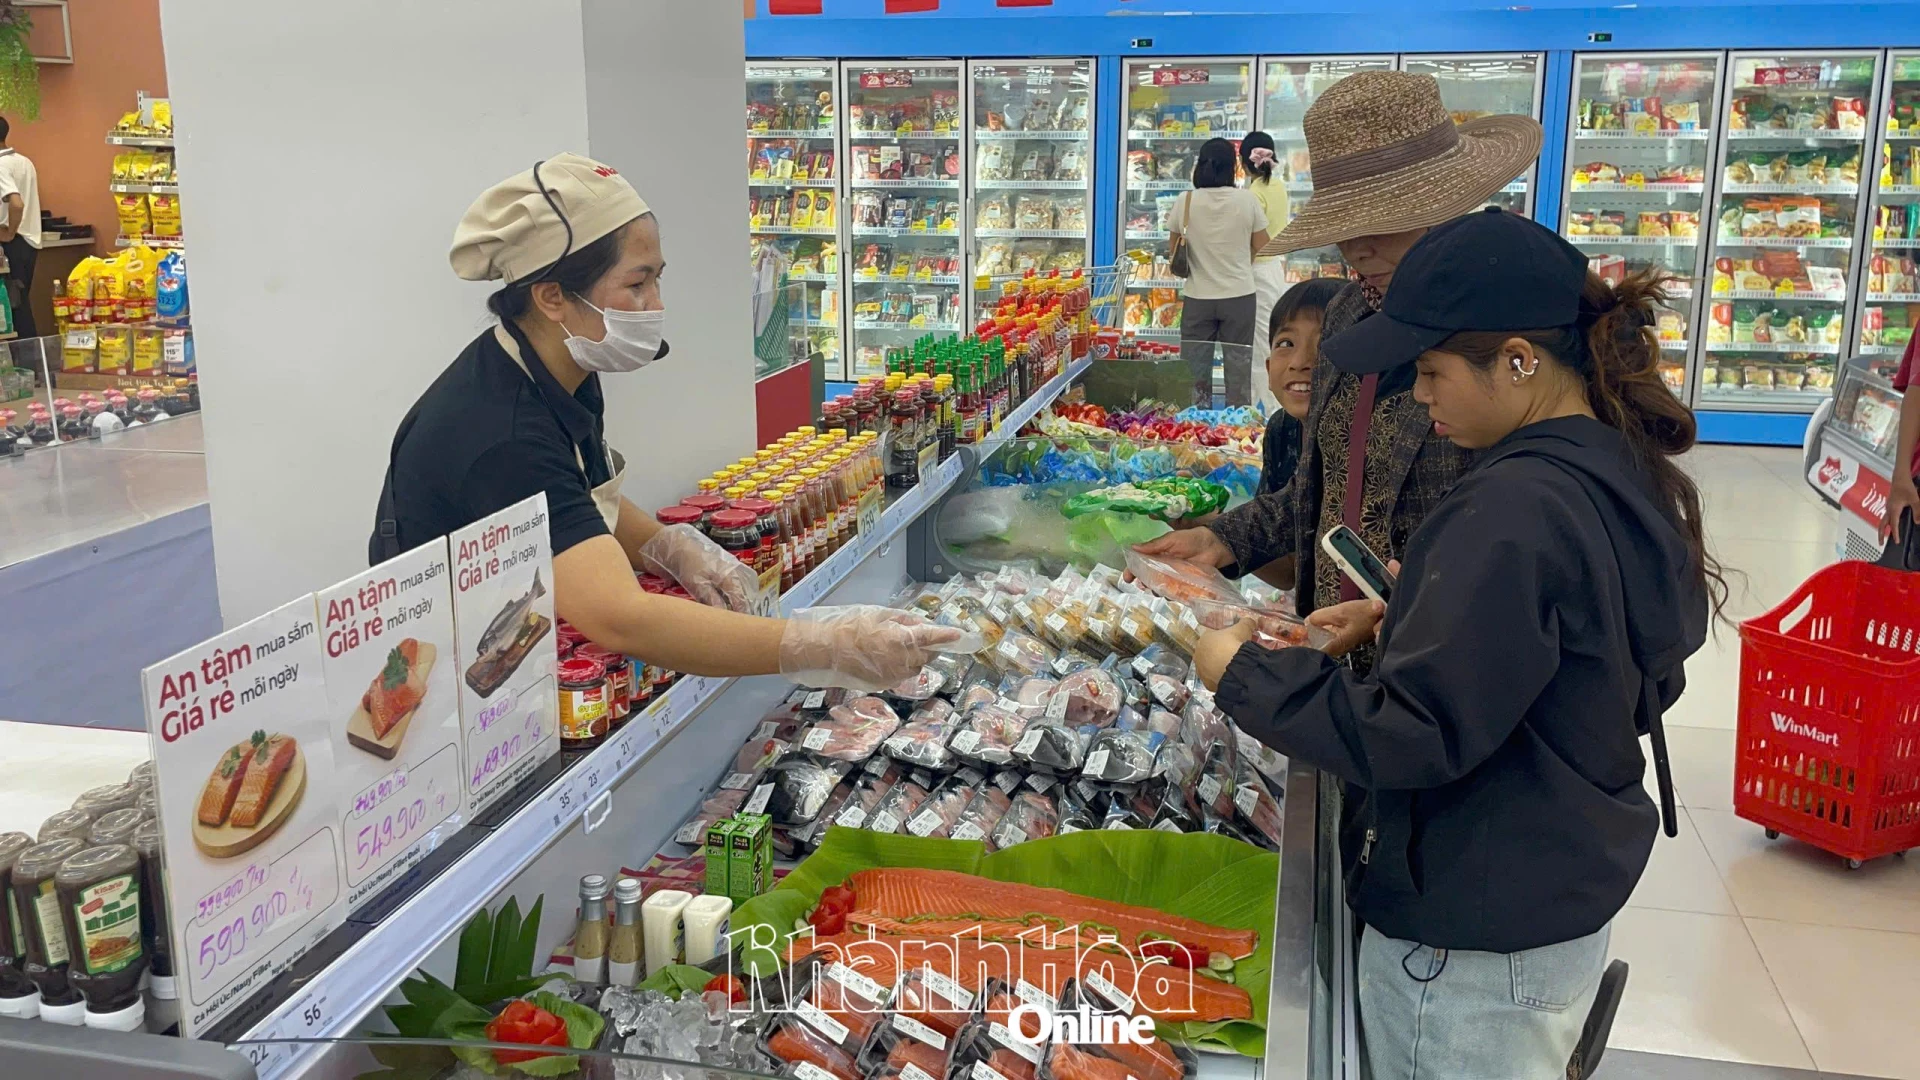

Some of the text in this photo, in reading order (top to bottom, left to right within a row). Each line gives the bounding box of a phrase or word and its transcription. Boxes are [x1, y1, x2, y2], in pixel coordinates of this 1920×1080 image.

[457, 511, 547, 566] An tâm mua sắm
[325, 560, 446, 628] An tâm mua sắm
[457, 542, 538, 594] Giá rẻ mỗi ngày
[326, 597, 433, 659] Giá rẻ mỗi ngày
[159, 619, 315, 709] An tâm mua sắm
[160, 662, 300, 744] Giá rẻ mỗi ngày
[1770, 711, 1840, 748] WinMart
[303, 1002, 322, 1027] 56
